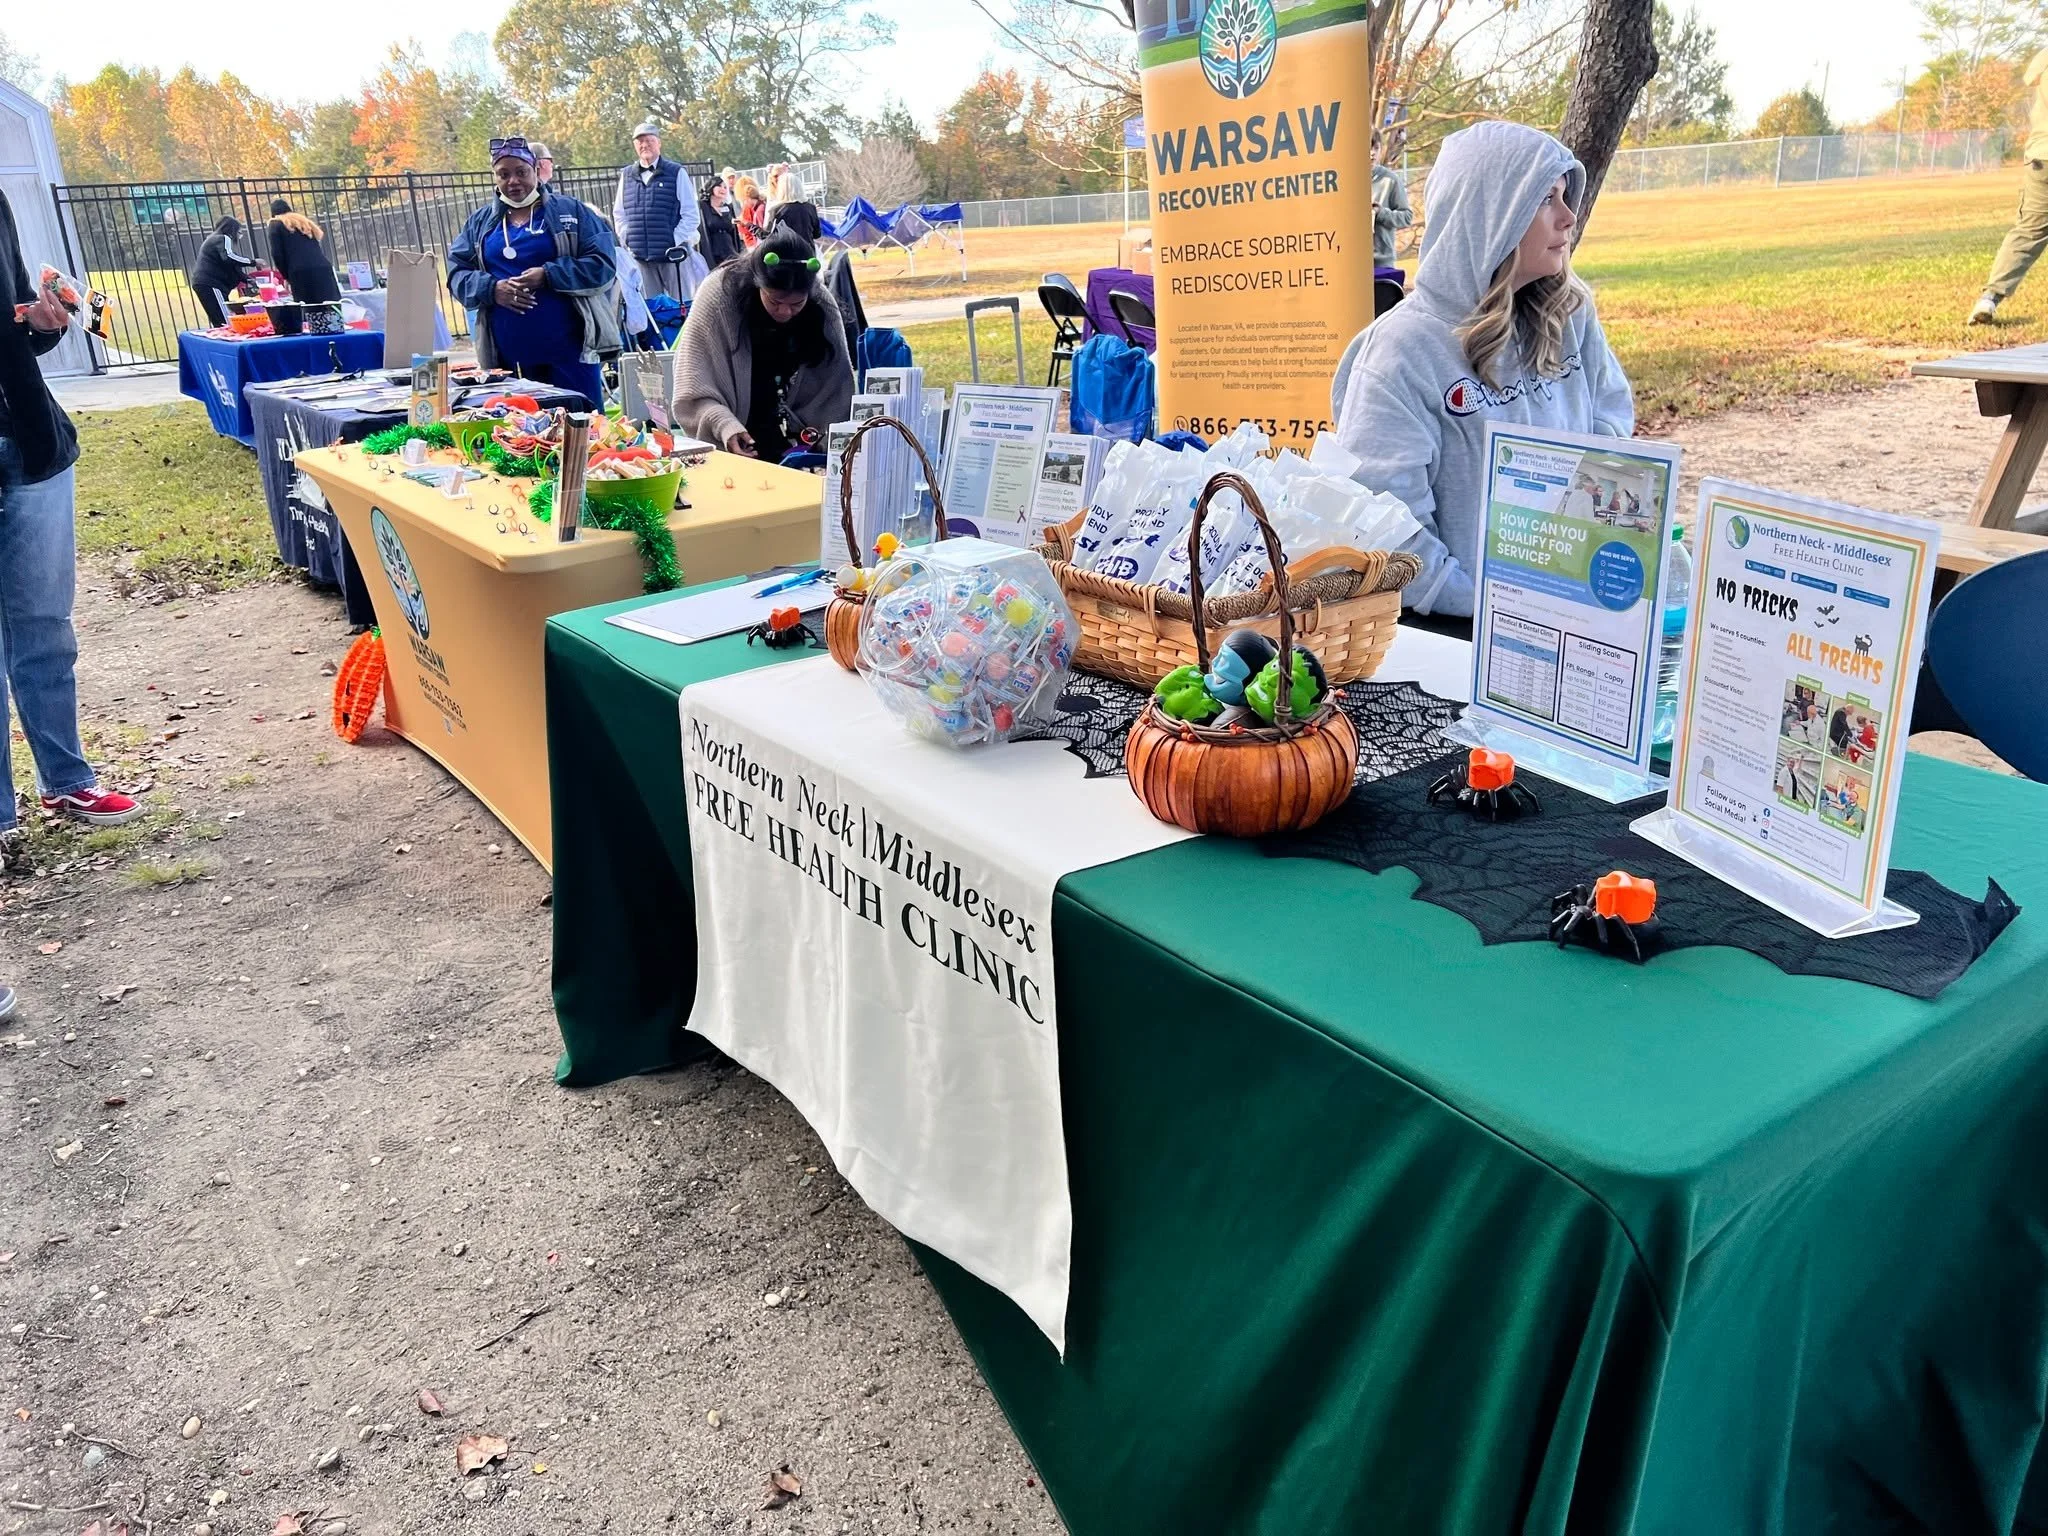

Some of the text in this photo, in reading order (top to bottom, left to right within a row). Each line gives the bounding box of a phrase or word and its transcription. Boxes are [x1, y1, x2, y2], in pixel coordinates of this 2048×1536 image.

[1152, 101, 1341, 176] WARSAW
[1158, 170, 1339, 213] RECOVERY CENTER
[1160, 230, 1341, 264] EMBRACE SOBRIETY,
[1172, 267, 1329, 295] REDISCOVER LIFE.
[1500, 511, 1587, 542] HOW CAN YOU
[1497, 542, 1551, 566] SERVICE?
[1498, 528, 1573, 556] QUALIFY FOR
[1753, 523, 1797, 543] Northern
[1799, 534, 1825, 551] Neck
[1833, 542, 1893, 567] Middlesex
[1773, 543, 1865, 577] FREE HEALTH CLINIC
[1716, 577, 1799, 623] NO TRICKS
[1498, 616, 1517, 627] Medical
[1523, 624, 1539, 633] Dental
[1540, 629, 1554, 638] Clinic
[1710, 622, 1719, 631] We
[1720, 626, 1735, 635] serve
[1740, 633, 1767, 648] counties:
[407, 632, 446, 674] WARSAW
[1579, 641, 1602, 656] Sliding
[1602, 648, 1621, 659] Scale
[1786, 632, 1884, 685] ALL TREATS
[1566, 662, 1595, 677] FPL Range
[1604, 672, 1625, 685] Copay
[1704, 675, 1729, 690] Discounted
[1704, 797, 1747, 824] Social Media!
[1706, 785, 1747, 811] Follow us on
[691, 717, 785, 802] Northern
[796, 774, 856, 847] Neck
[872, 819, 1037, 953] Middlesex
[692, 769, 1044, 1024] FREE HEALTH CLINIC
